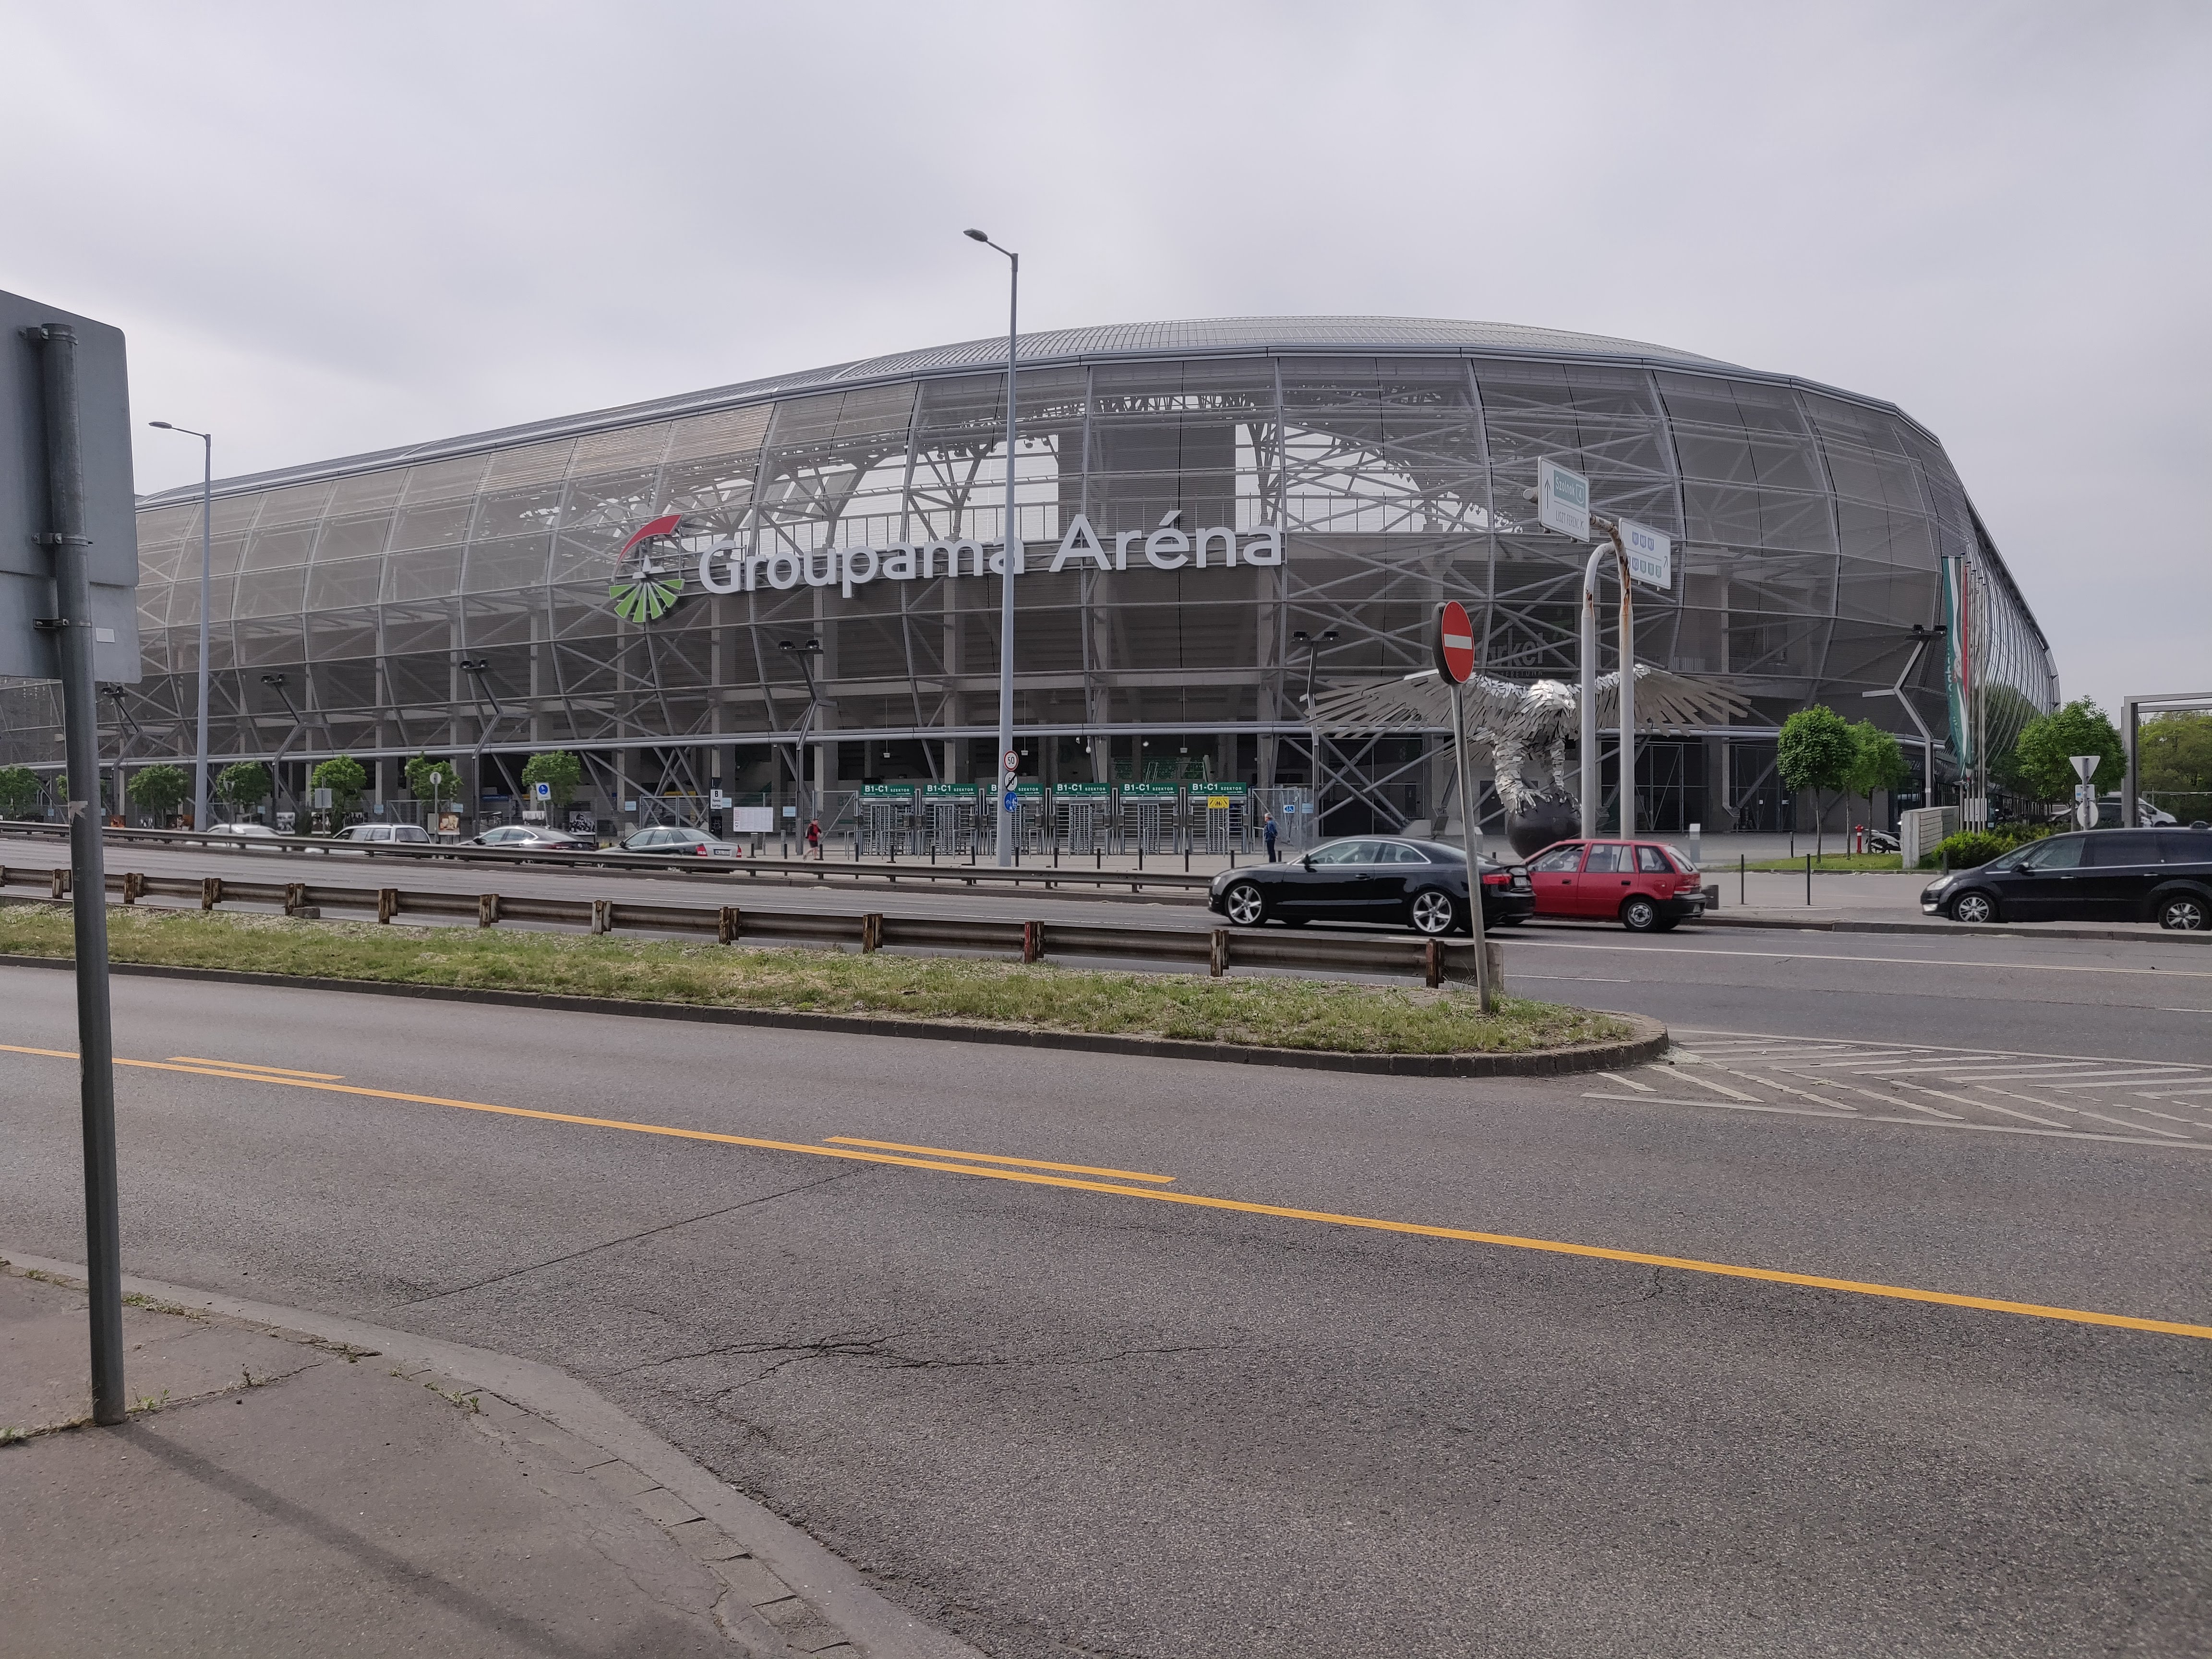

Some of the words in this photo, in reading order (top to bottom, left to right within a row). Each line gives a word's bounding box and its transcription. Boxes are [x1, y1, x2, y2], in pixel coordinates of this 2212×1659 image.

[1555, 476, 1575, 496] Szolnok
[1556, 510, 1566, 524] LISZT
[1567, 514, 1579, 529] FERENC
[699, 536, 1024, 598] Groupama
[1049, 510, 1281, 572] Aréna
[1008, 756, 1014, 765] 50
